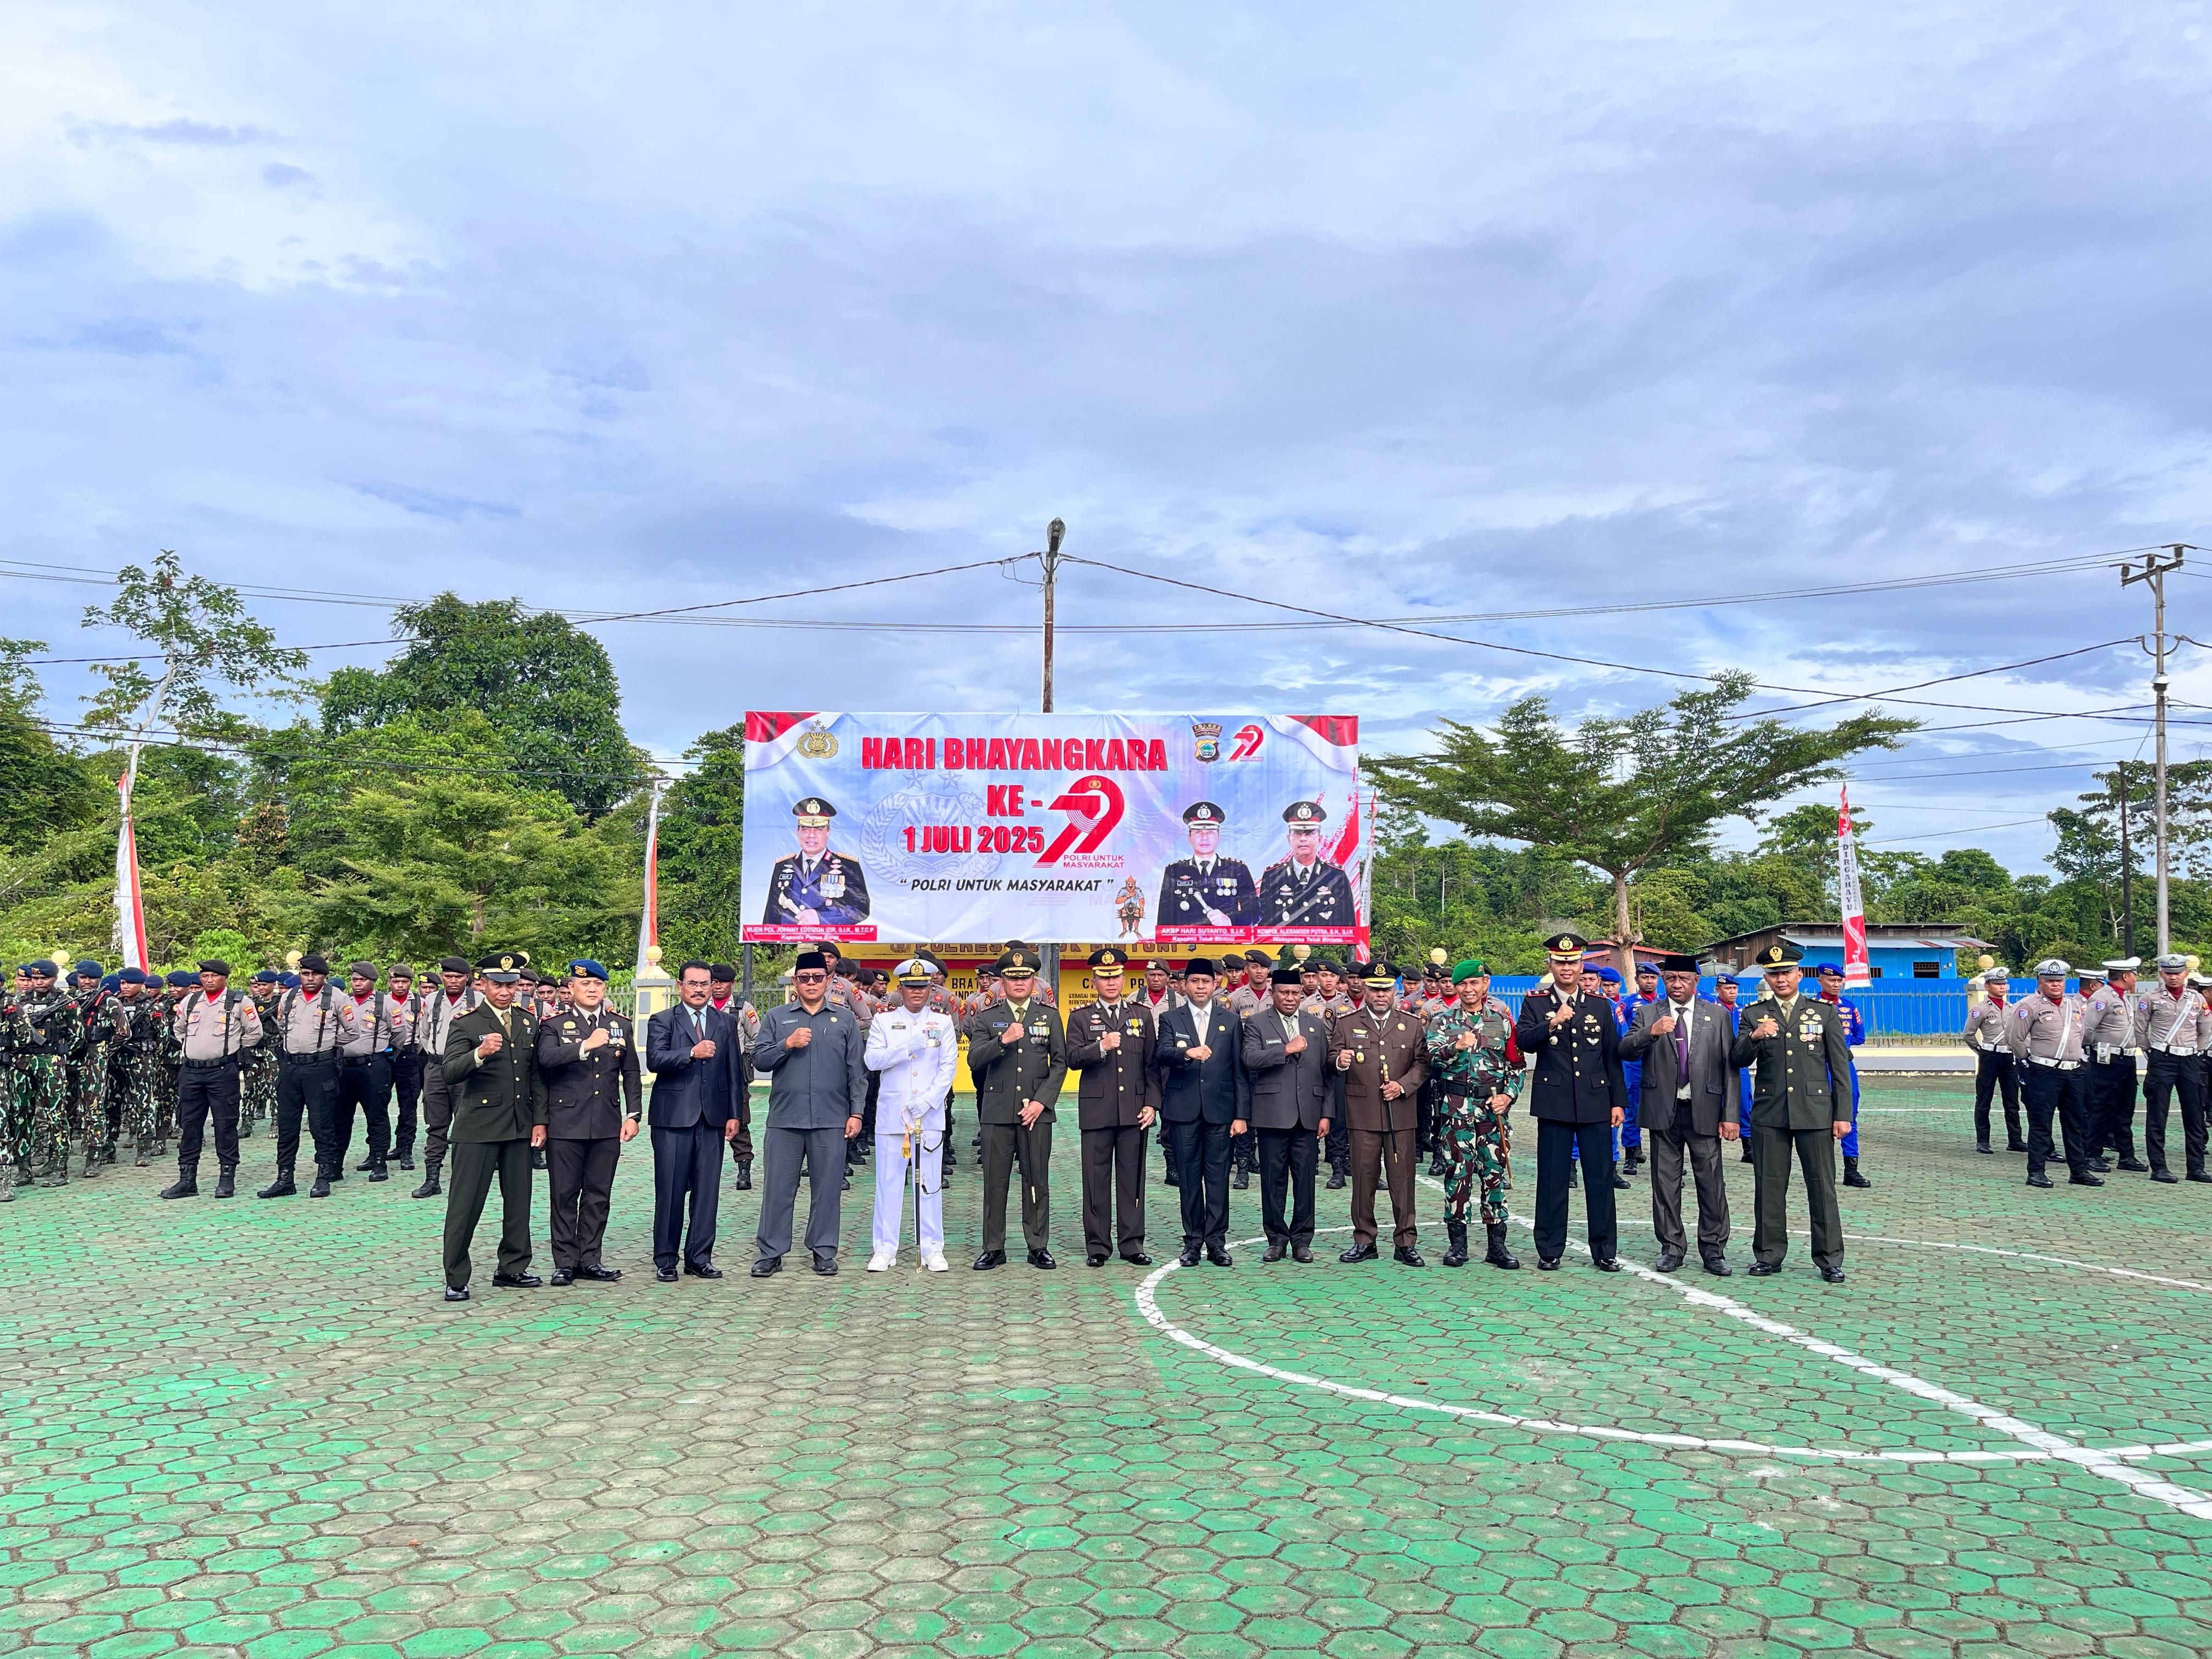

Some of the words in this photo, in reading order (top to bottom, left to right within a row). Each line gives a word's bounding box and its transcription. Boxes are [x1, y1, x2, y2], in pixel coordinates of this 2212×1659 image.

[862, 737, 935, 770] HARI
[944, 737, 1169, 771] BHAYANGKARA
[987, 785, 1024, 817] KE
[902, 826, 916, 853] 1
[921, 826, 972, 853] JULI
[977, 826, 1045, 854] 2025
[911, 879, 951, 891] POLRI
[956, 879, 1003, 891] UNTUK
[1007, 879, 1103, 891] MASYARAKAT
[1843, 844, 1852, 910] DIRGAHAYU
